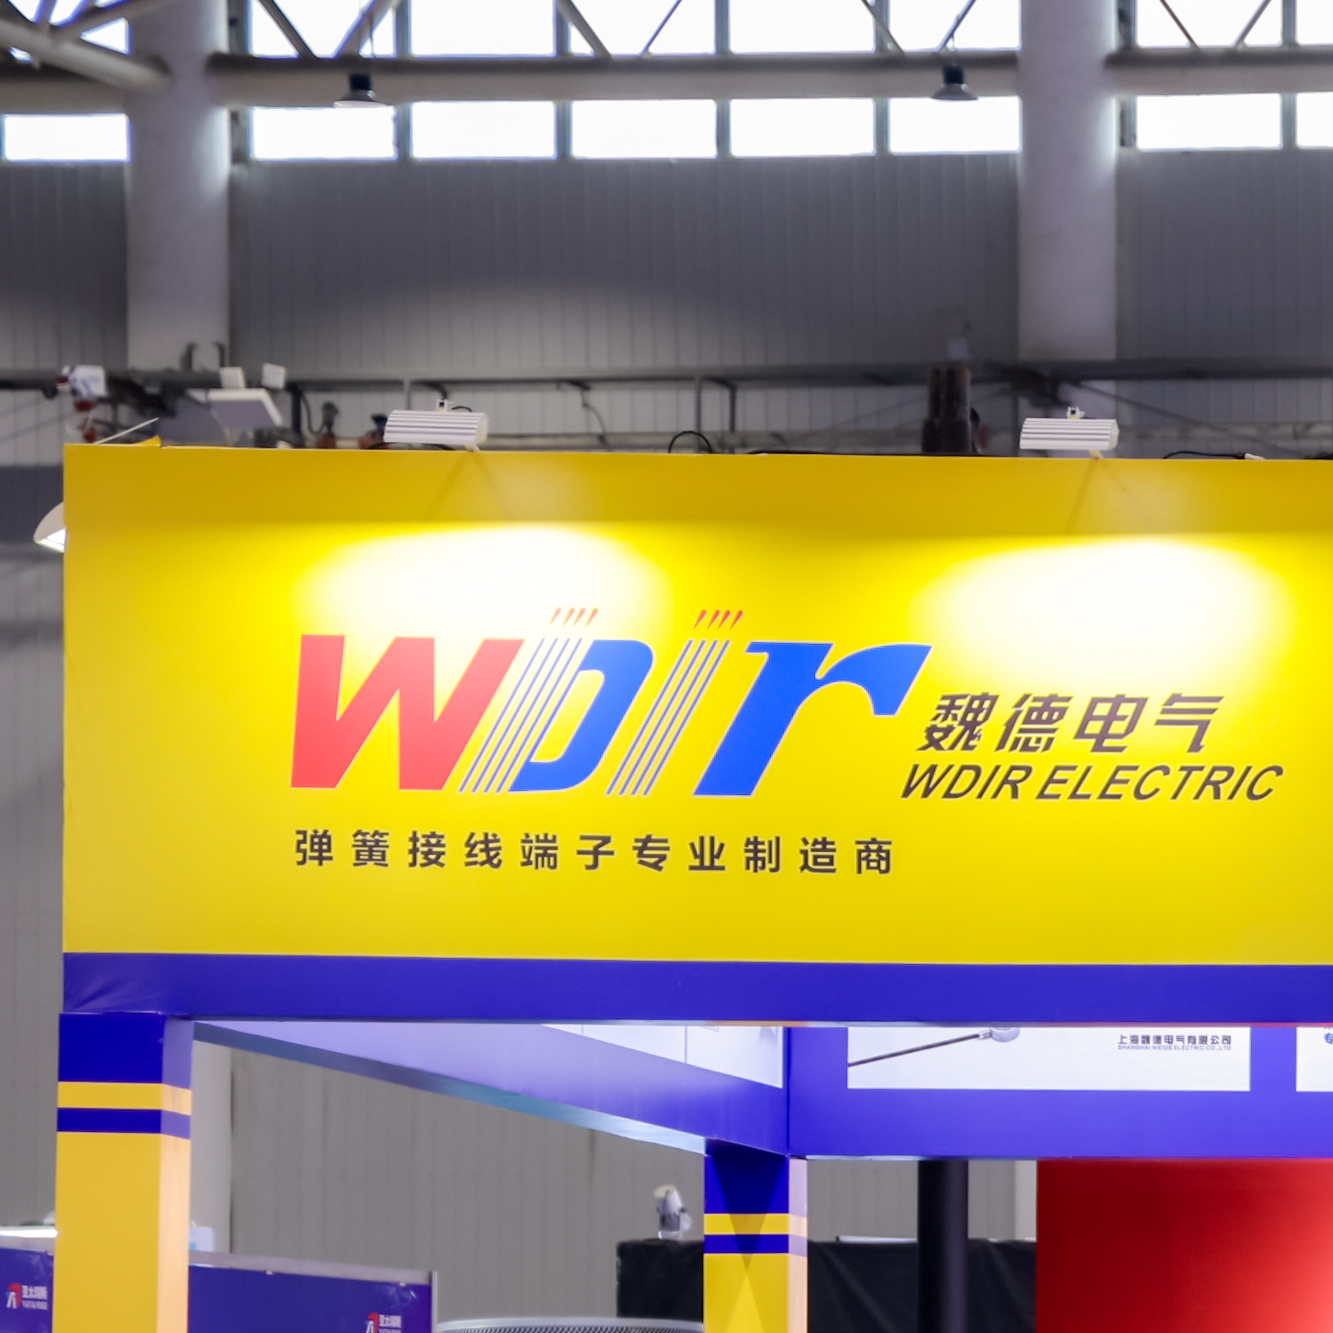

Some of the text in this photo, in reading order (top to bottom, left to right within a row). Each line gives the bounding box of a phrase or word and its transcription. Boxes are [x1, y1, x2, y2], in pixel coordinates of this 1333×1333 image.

[916, 691, 1226, 753] 魏德电气
[900, 764, 1284, 801] WDIR ELECTRIC
[294, 829, 894, 875] 弹簧接线端子专业制造商
[1117, 1035, 1232, 1045] 上海魏德电气有限公司
